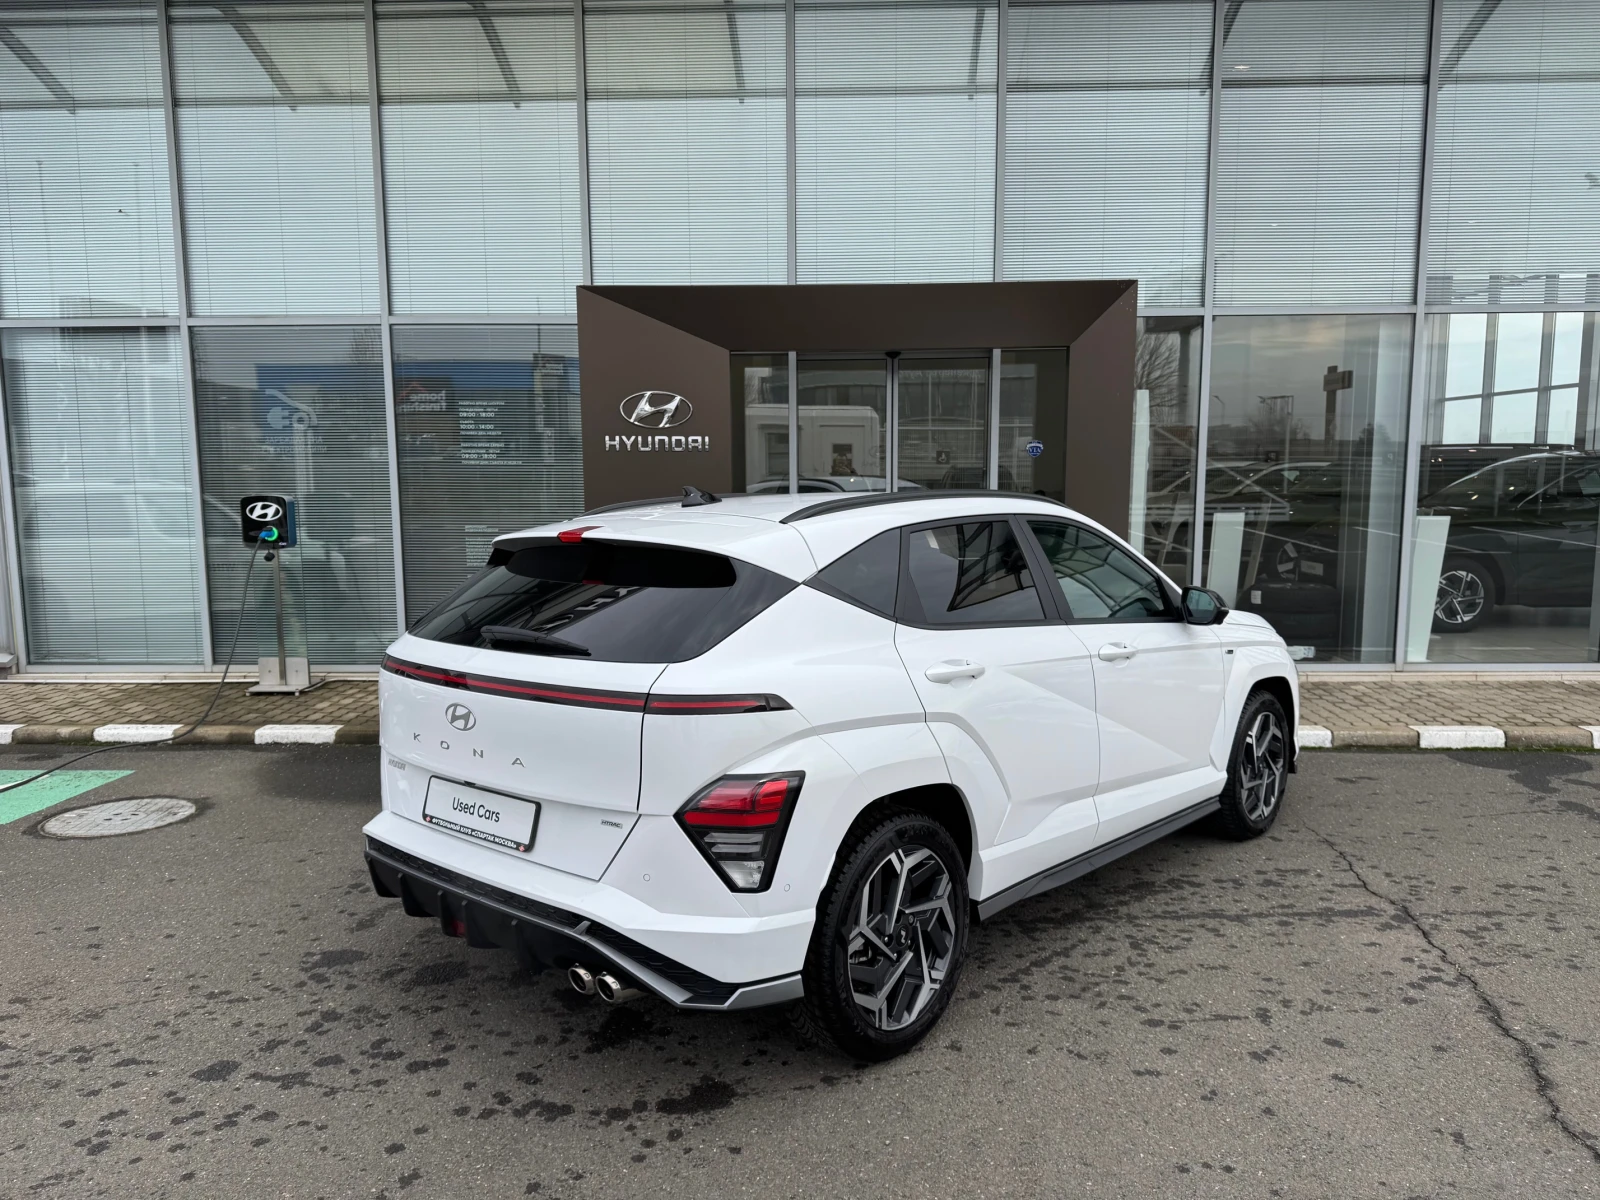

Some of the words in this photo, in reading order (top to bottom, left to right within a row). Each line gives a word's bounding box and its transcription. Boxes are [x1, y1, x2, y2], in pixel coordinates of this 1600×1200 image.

[605, 435, 709, 452] HYUNDAI
[413, 732, 525, 768] KONA
[452, 796, 476, 815] Used
[477, 804, 500, 823] Cars
